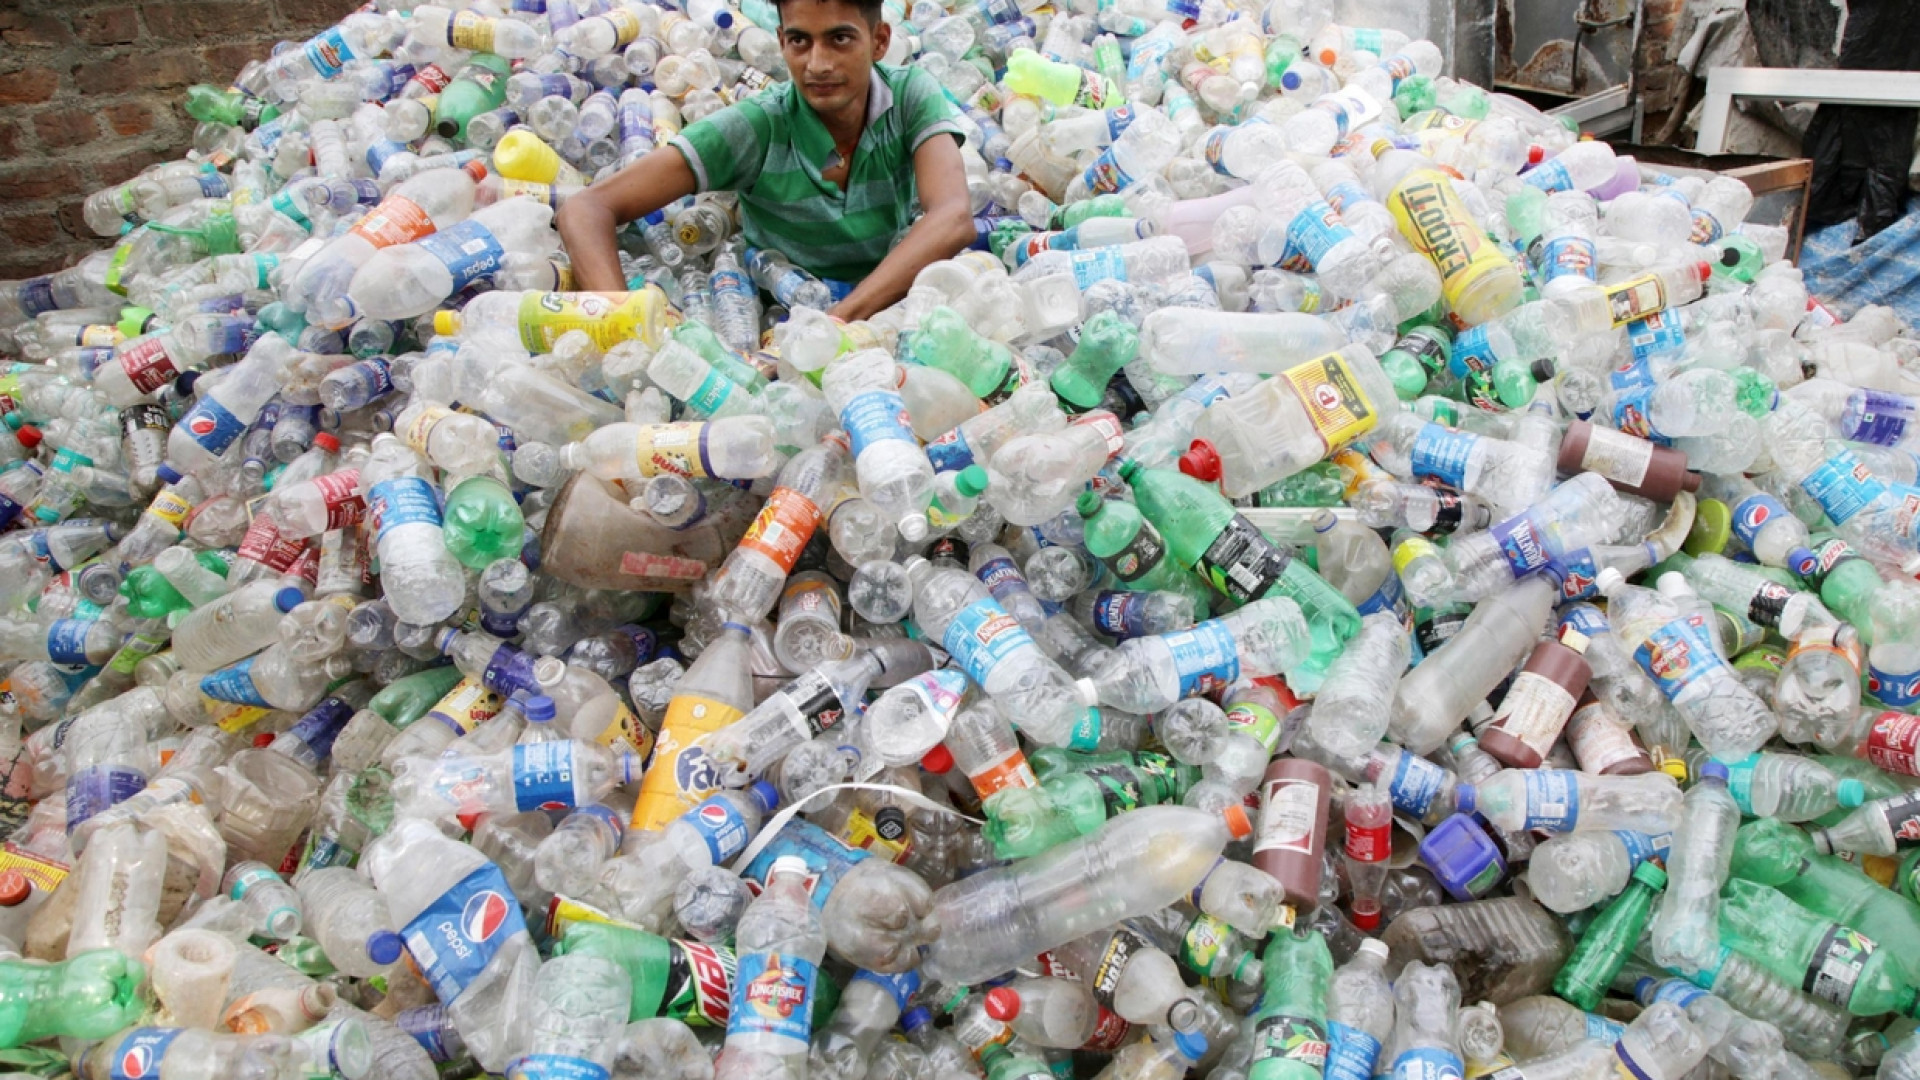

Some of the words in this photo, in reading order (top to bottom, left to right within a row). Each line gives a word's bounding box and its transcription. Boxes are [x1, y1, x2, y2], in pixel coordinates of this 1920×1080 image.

[1405, 182, 1467, 280] FROOTI
[461, 255, 496, 278] pepsi
[437, 919, 473, 960] pepsi
[749, 983, 803, 1004] KINGFISHER
